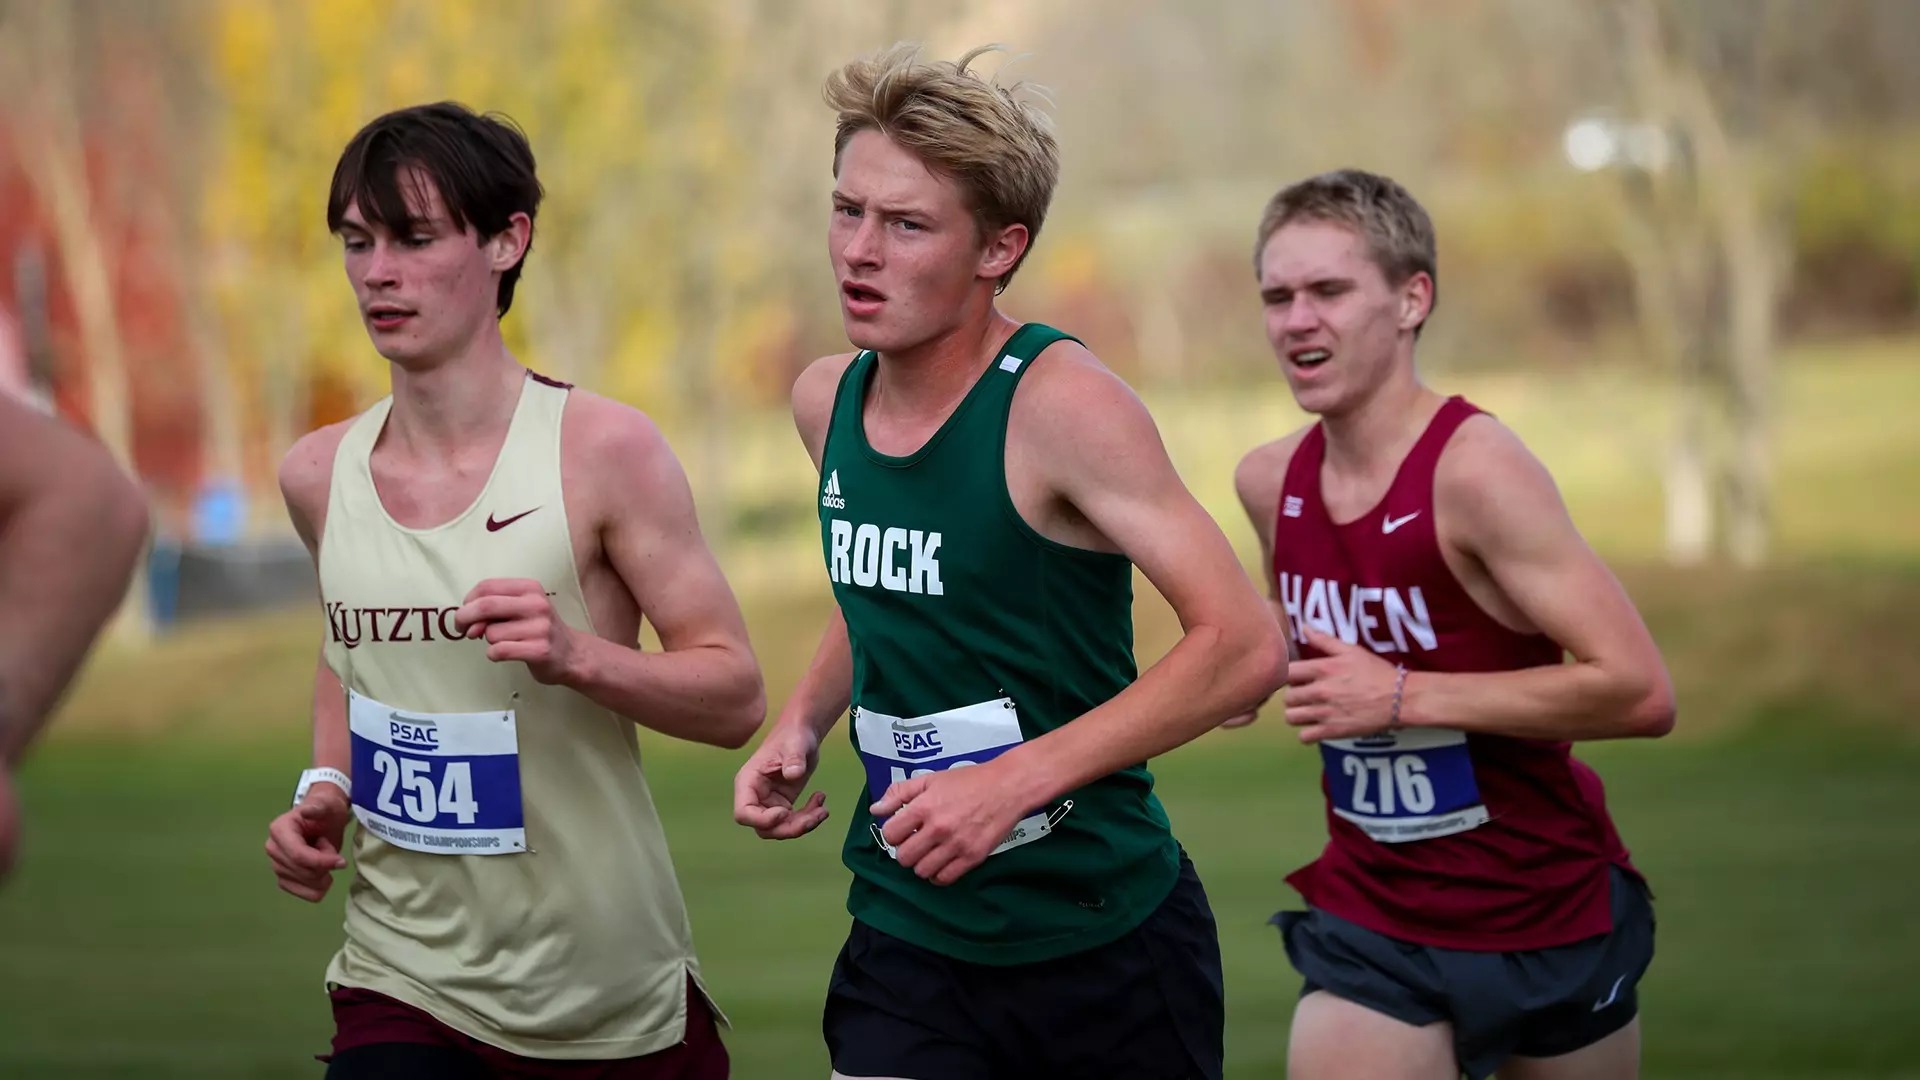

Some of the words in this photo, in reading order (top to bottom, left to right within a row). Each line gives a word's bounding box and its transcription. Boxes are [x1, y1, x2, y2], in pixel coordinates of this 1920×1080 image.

[822, 493, 846, 509] adidas
[830, 519, 944, 596] ROCK
[326, 598, 515, 650] KUTZTO
[1280, 571, 1438, 653] HAVEN
[389, 722, 439, 743] PSAC
[892, 729, 942, 750] PSAC
[373, 750, 479, 824] 254
[1341, 754, 1436, 815] 276
[388, 827, 422, 844] COUNTRY
[423, 834, 500, 848] CHAMPIONSHIPS
